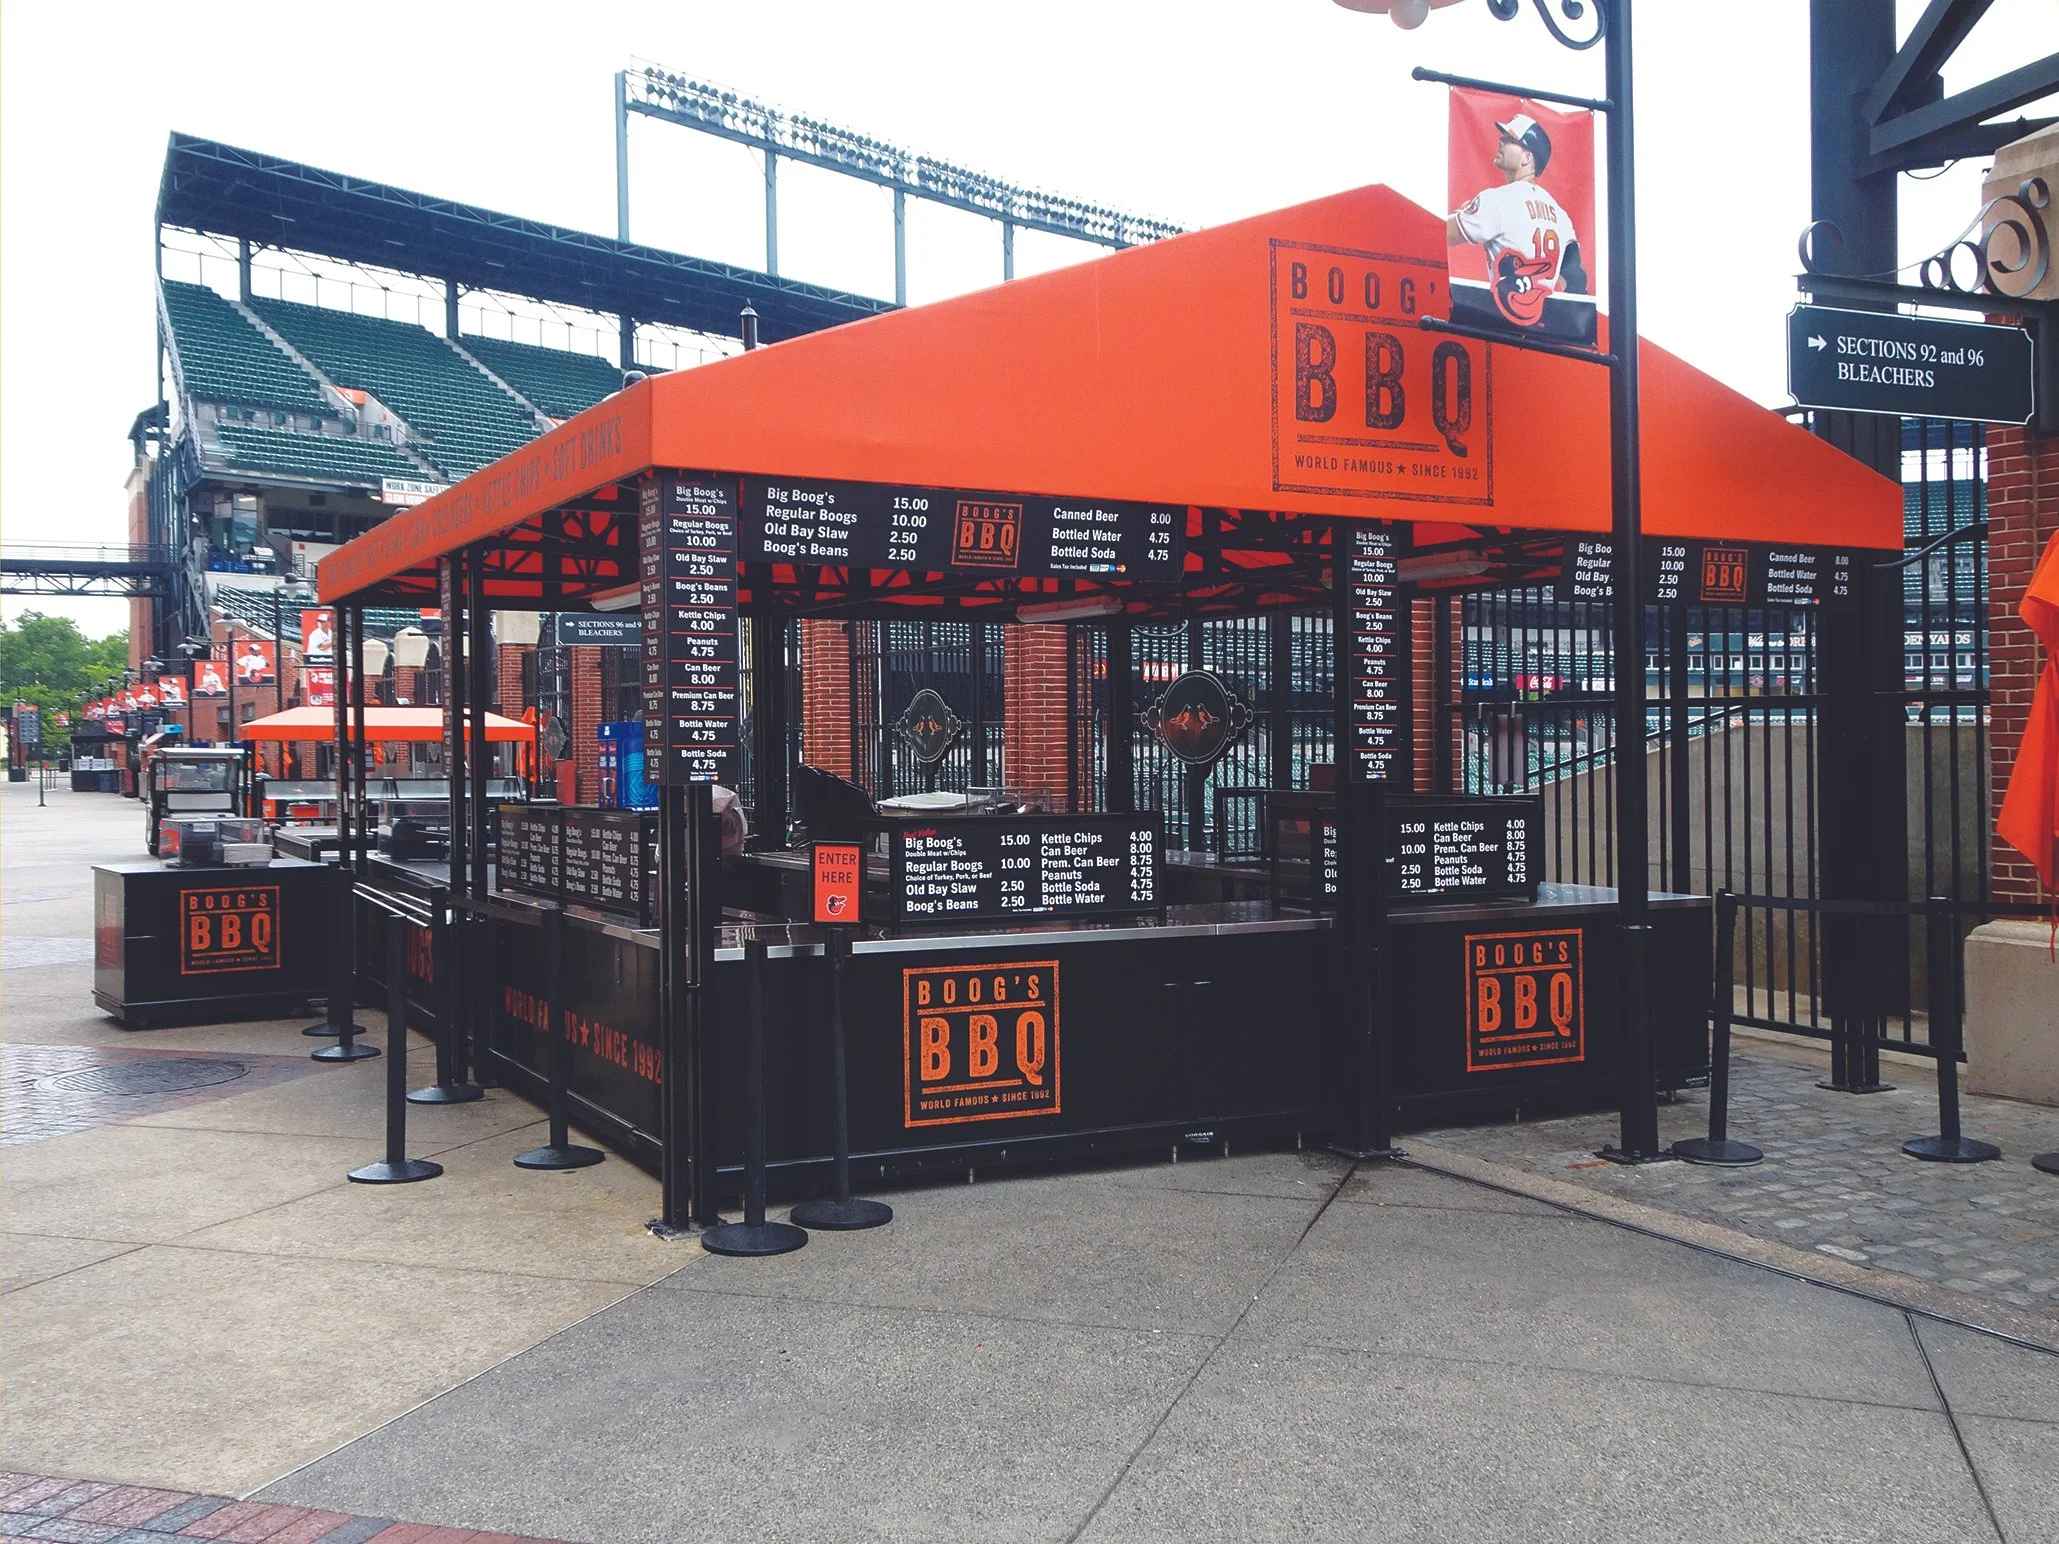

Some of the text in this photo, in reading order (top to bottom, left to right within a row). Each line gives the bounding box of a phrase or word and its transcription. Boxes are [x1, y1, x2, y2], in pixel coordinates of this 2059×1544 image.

[1525, 199, 1558, 224] DAVIS
[1291, 262, 1435, 315] BOOG'
[1837, 336, 1984, 367] SECTIONS 92 and 96
[1837, 362, 1935, 388] BLEACHERS
[1295, 322, 1472, 458] BBQ
[581, 415, 622, 469] DRINKS
[1295, 455, 1479, 480] WORLD FAMOUS SINCE 1992
[385, 482, 404, 490] WORK
[407, 483, 422, 492] ZONE
[676, 486, 724, 497] Big Boog's
[767, 487, 929, 511] Big Boog's 15.00
[686, 504, 716, 515] 15.00
[766, 505, 927, 527] Regular Boogs 10.00
[962, 506, 1014, 520] BOOG'S
[1053, 507, 1171, 525] Canned Beer 8.00
[673, 520, 729, 531] Regular Boogs
[765, 522, 918, 544] Old Bay Slaw 2.50
[960, 521, 1015, 555] BBQ
[1052, 528, 1170, 544] Bottled Water 4.75
[686, 536, 716, 546] 10.00
[764, 540, 916, 561] Boog's Beans 2.50
[1051, 546, 1169, 561] Bottled Soda 4.75
[1363, 547, 1384, 556] 15.00
[1661, 547, 1685, 557] 15.00
[676, 553, 727, 563] Old Bay Slaw
[1576, 557, 1684, 571] Regular 10.00
[1706, 552, 1743, 563] BOOG'S
[689, 565, 714, 575] 2.50
[1363, 573, 1384, 583] 10.00
[1705, 565, 1743, 592] BBQ
[675, 582, 728, 592] Boog's Beans
[690, 594, 714, 604] 2.50
[1365, 597, 1383, 607] 2.50
[678, 611, 726, 620] Kettle Chips
[690, 621, 714, 631] 4.00
[578, 629, 623, 637] BLEACHERS
[687, 637, 718, 646] Peanuts
[690, 647, 714, 656] 4.75
[685, 664, 721, 672] Can Beer
[691, 674, 715, 684] 8.00
[672, 691, 734, 700] Premium Can Beer
[1366, 689, 1384, 698] 8.00
[691, 701, 715, 711] 8.75
[679, 720, 728, 728] Bottle Water
[692, 731, 715, 740] 4.75
[681, 750, 726, 758] Bottle Soda
[692, 760, 716, 769] 4.75
[1367, 760, 1385, 769] 4.75
[1400, 820, 1525, 833] 15.00 Kettle Chips 4.00
[905, 835, 1030, 851] Big Boog's 15.00
[1041, 831, 1152, 845] Kettle Chips 4.00
[1434, 830, 1525, 843] Can Beer 8.00
[905, 850, 924, 858] Double
[1041, 843, 1153, 855] Can Beer 8.00
[1401, 844, 1426, 854] 10.00
[818, 852, 856, 865] ENTER
[1041, 855, 1153, 869] Prem. Can Beer 8.75
[1434, 852, 1526, 865] Peanuts 4.75
[905, 858, 1031, 874] Regular Boogs 10.00
[822, 871, 853, 884] HERE
[1041, 867, 1153, 881] Peanuts 4.75
[906, 880, 1025, 897] Old Bay Slaw 2.50
[1041, 878, 1153, 893] Bottle Soda 4.75
[189, 893, 267, 910] BOOG'S
[1042, 890, 1153, 905] Bottle Water 4.75
[906, 896, 1025, 914] Boog's Beans 2.50
[191, 913, 271, 953] BBQ
[1476, 941, 1568, 967] BOOG'S
[918, 975, 1039, 1005] BOOG'S
[1478, 972, 1573, 1037] BBQ
[505, 986, 662, 1085] WORLD FAUS SINCE 1992
[920, 1011, 1045, 1086] BBQ
[920, 1089, 1050, 1110] WORLD FAMOUS SINCE 1992
